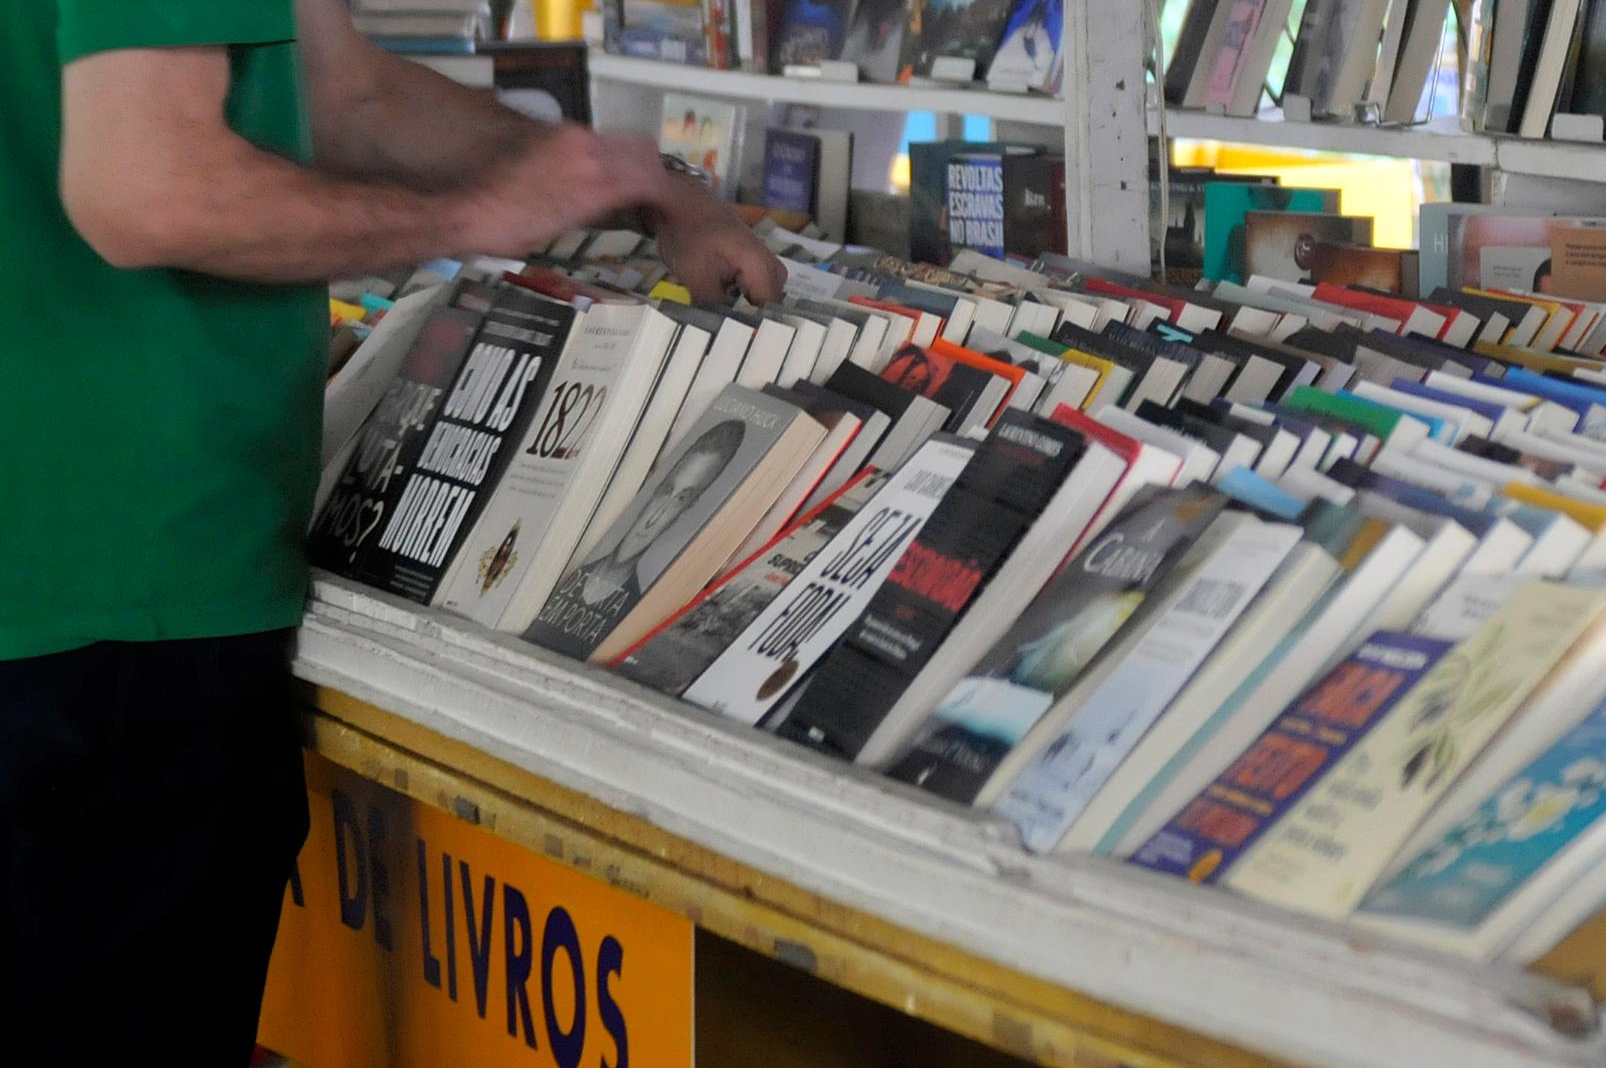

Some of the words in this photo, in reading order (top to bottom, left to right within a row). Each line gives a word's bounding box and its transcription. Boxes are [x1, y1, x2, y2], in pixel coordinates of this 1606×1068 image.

[948, 163, 1004, 192] REVOLTAS
[949, 192, 1005, 219] ESCRAVAS
[444, 342, 516, 424] COMO
[486, 353, 542, 432] AS
[526, 381, 608, 460] 1822
[417, 421, 503, 486] DEMOCRACIAS
[379, 473, 477, 568] MORREM
[416, 836, 631, 1068] LIVROS
